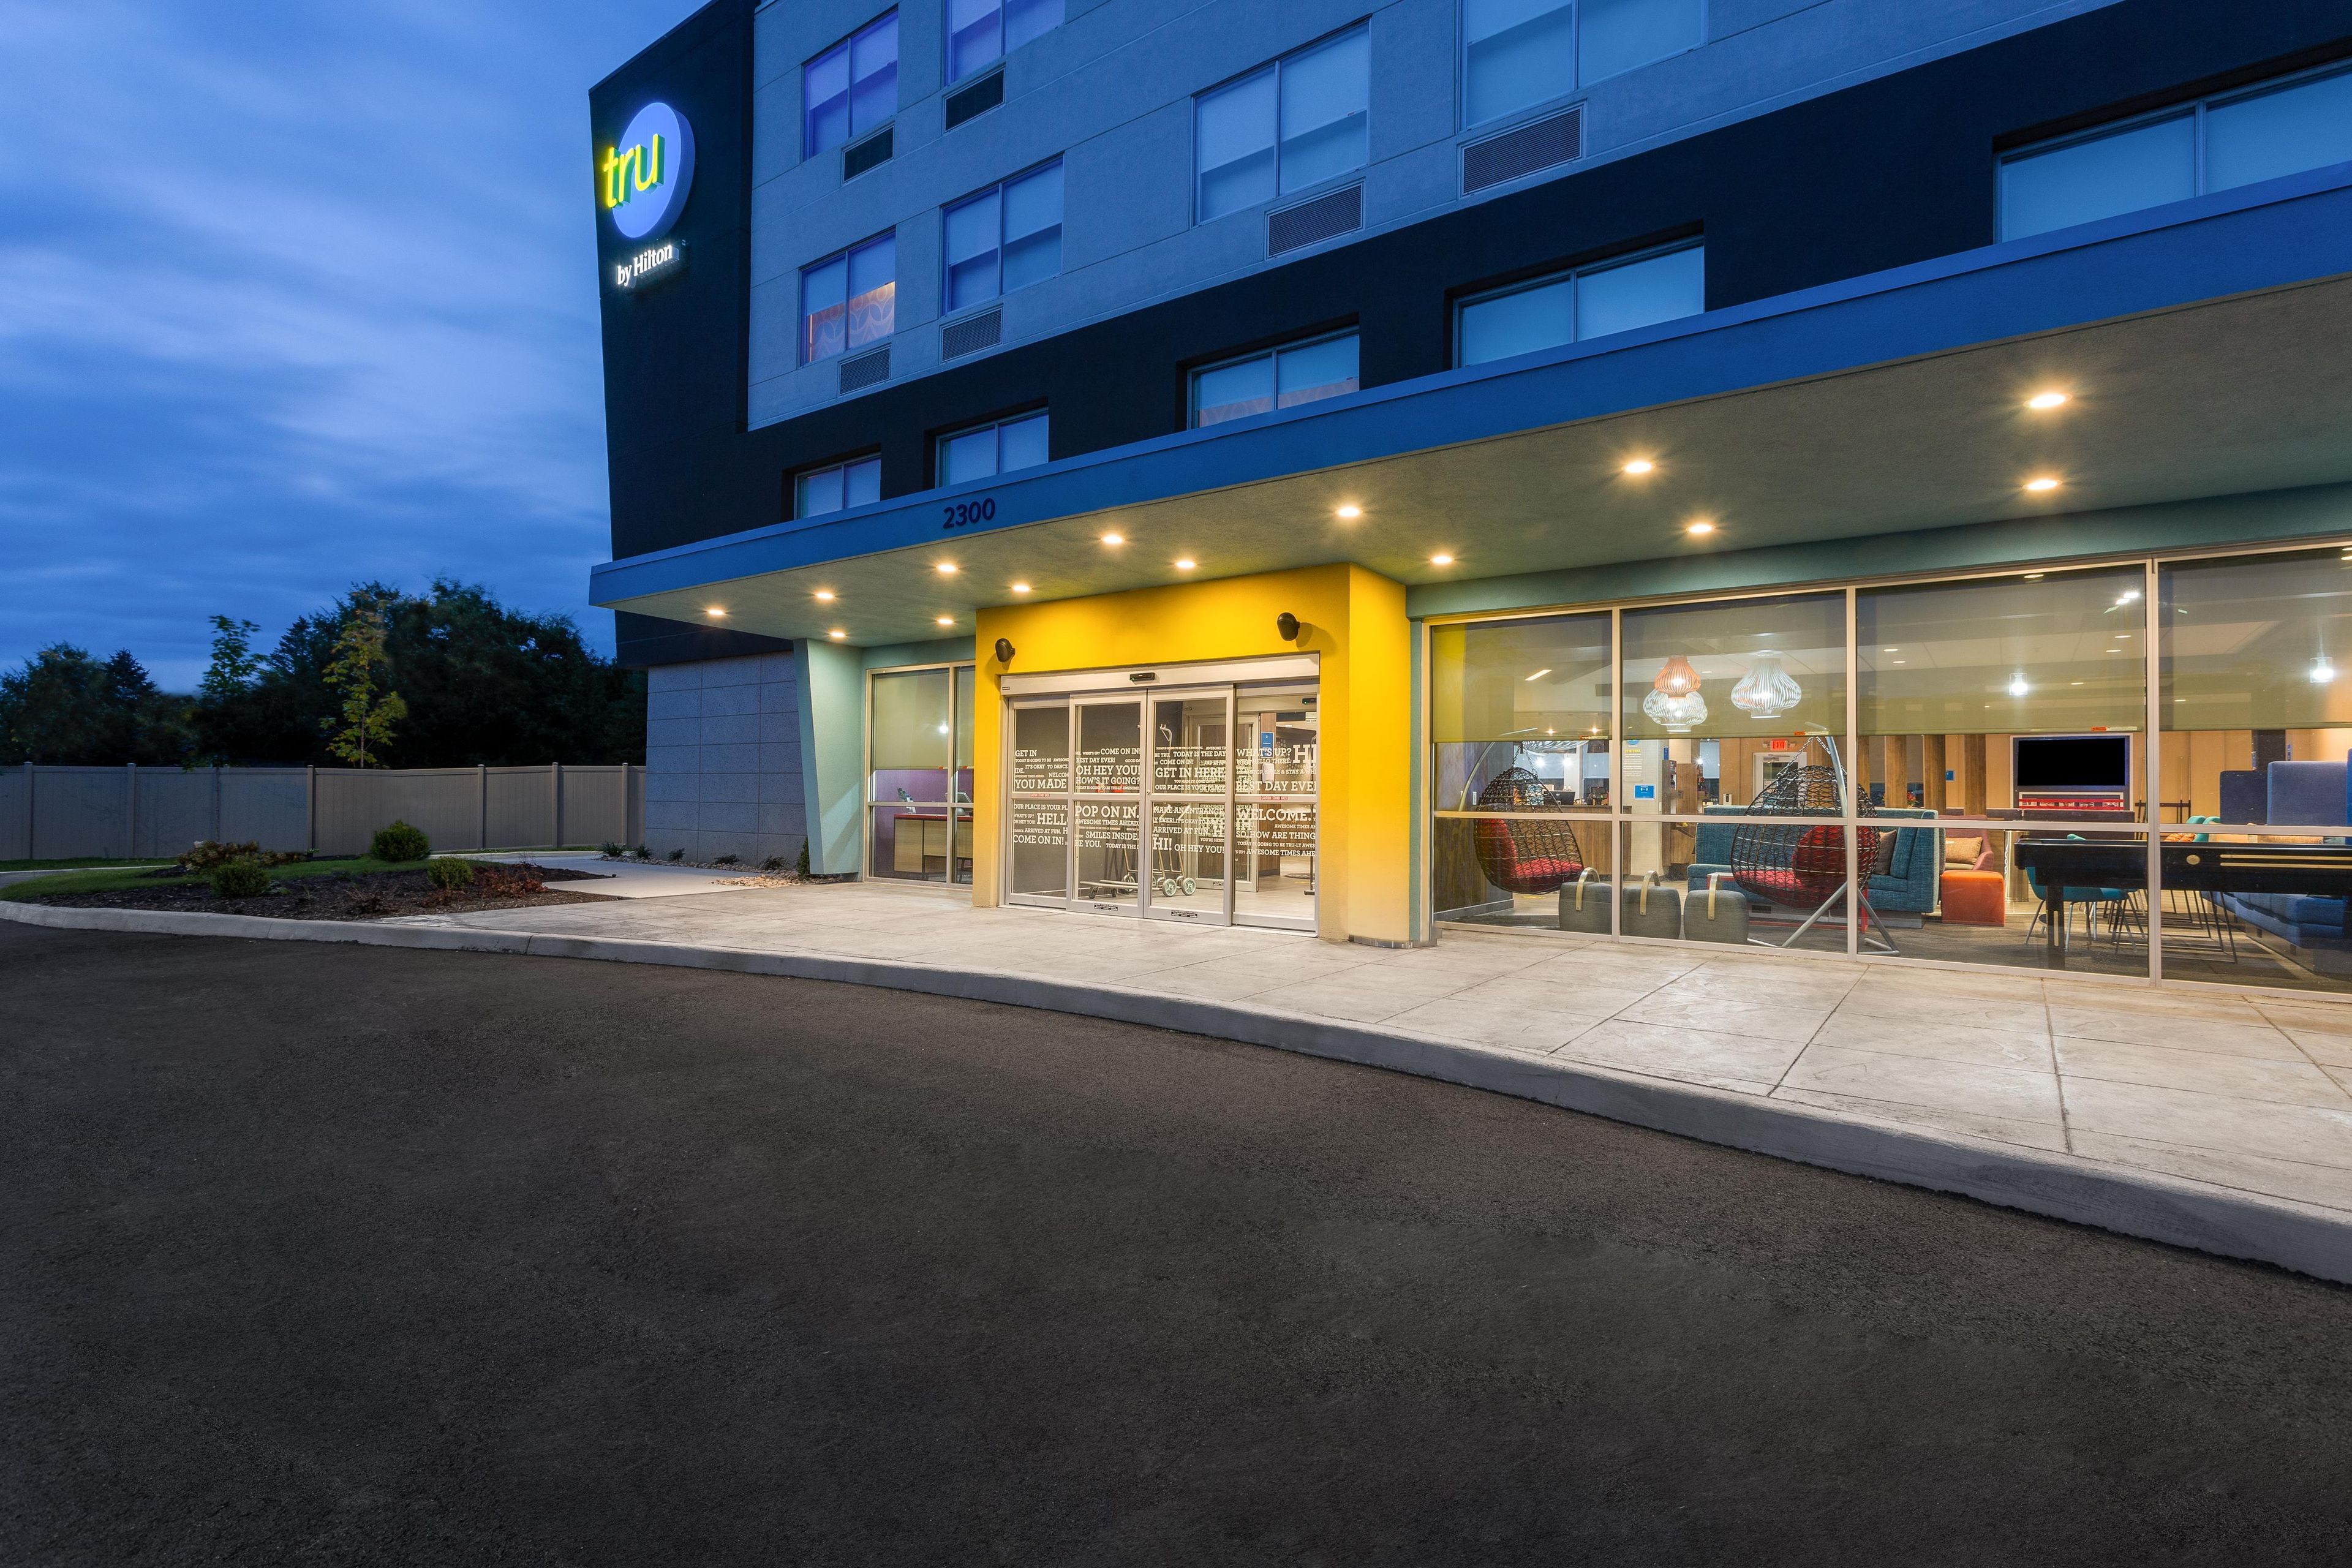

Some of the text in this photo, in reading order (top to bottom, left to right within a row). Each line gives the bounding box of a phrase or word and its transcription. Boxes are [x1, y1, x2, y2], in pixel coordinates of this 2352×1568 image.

[603, 134, 663, 209] tru
[617, 244, 673, 287] by Hilton
[943, 497, 996, 529] 2300
[1237, 748, 1273, 756] WHAT'S
[1076, 765, 1140, 775] OH HEY YOU!
[1155, 767, 1177, 778] GET
[1179, 767, 1192, 778] IN
[1015, 779, 1067, 789] YOU MADE
[1236, 781, 1262, 791] BEST
[1265, 781, 1289, 791] DAY
[1075, 805, 1139, 818] POP ON IN.
[1237, 809, 1311, 821] WELCOME.
[1013, 835, 1036, 843] COME
[1153, 837, 1172, 851] HI!
